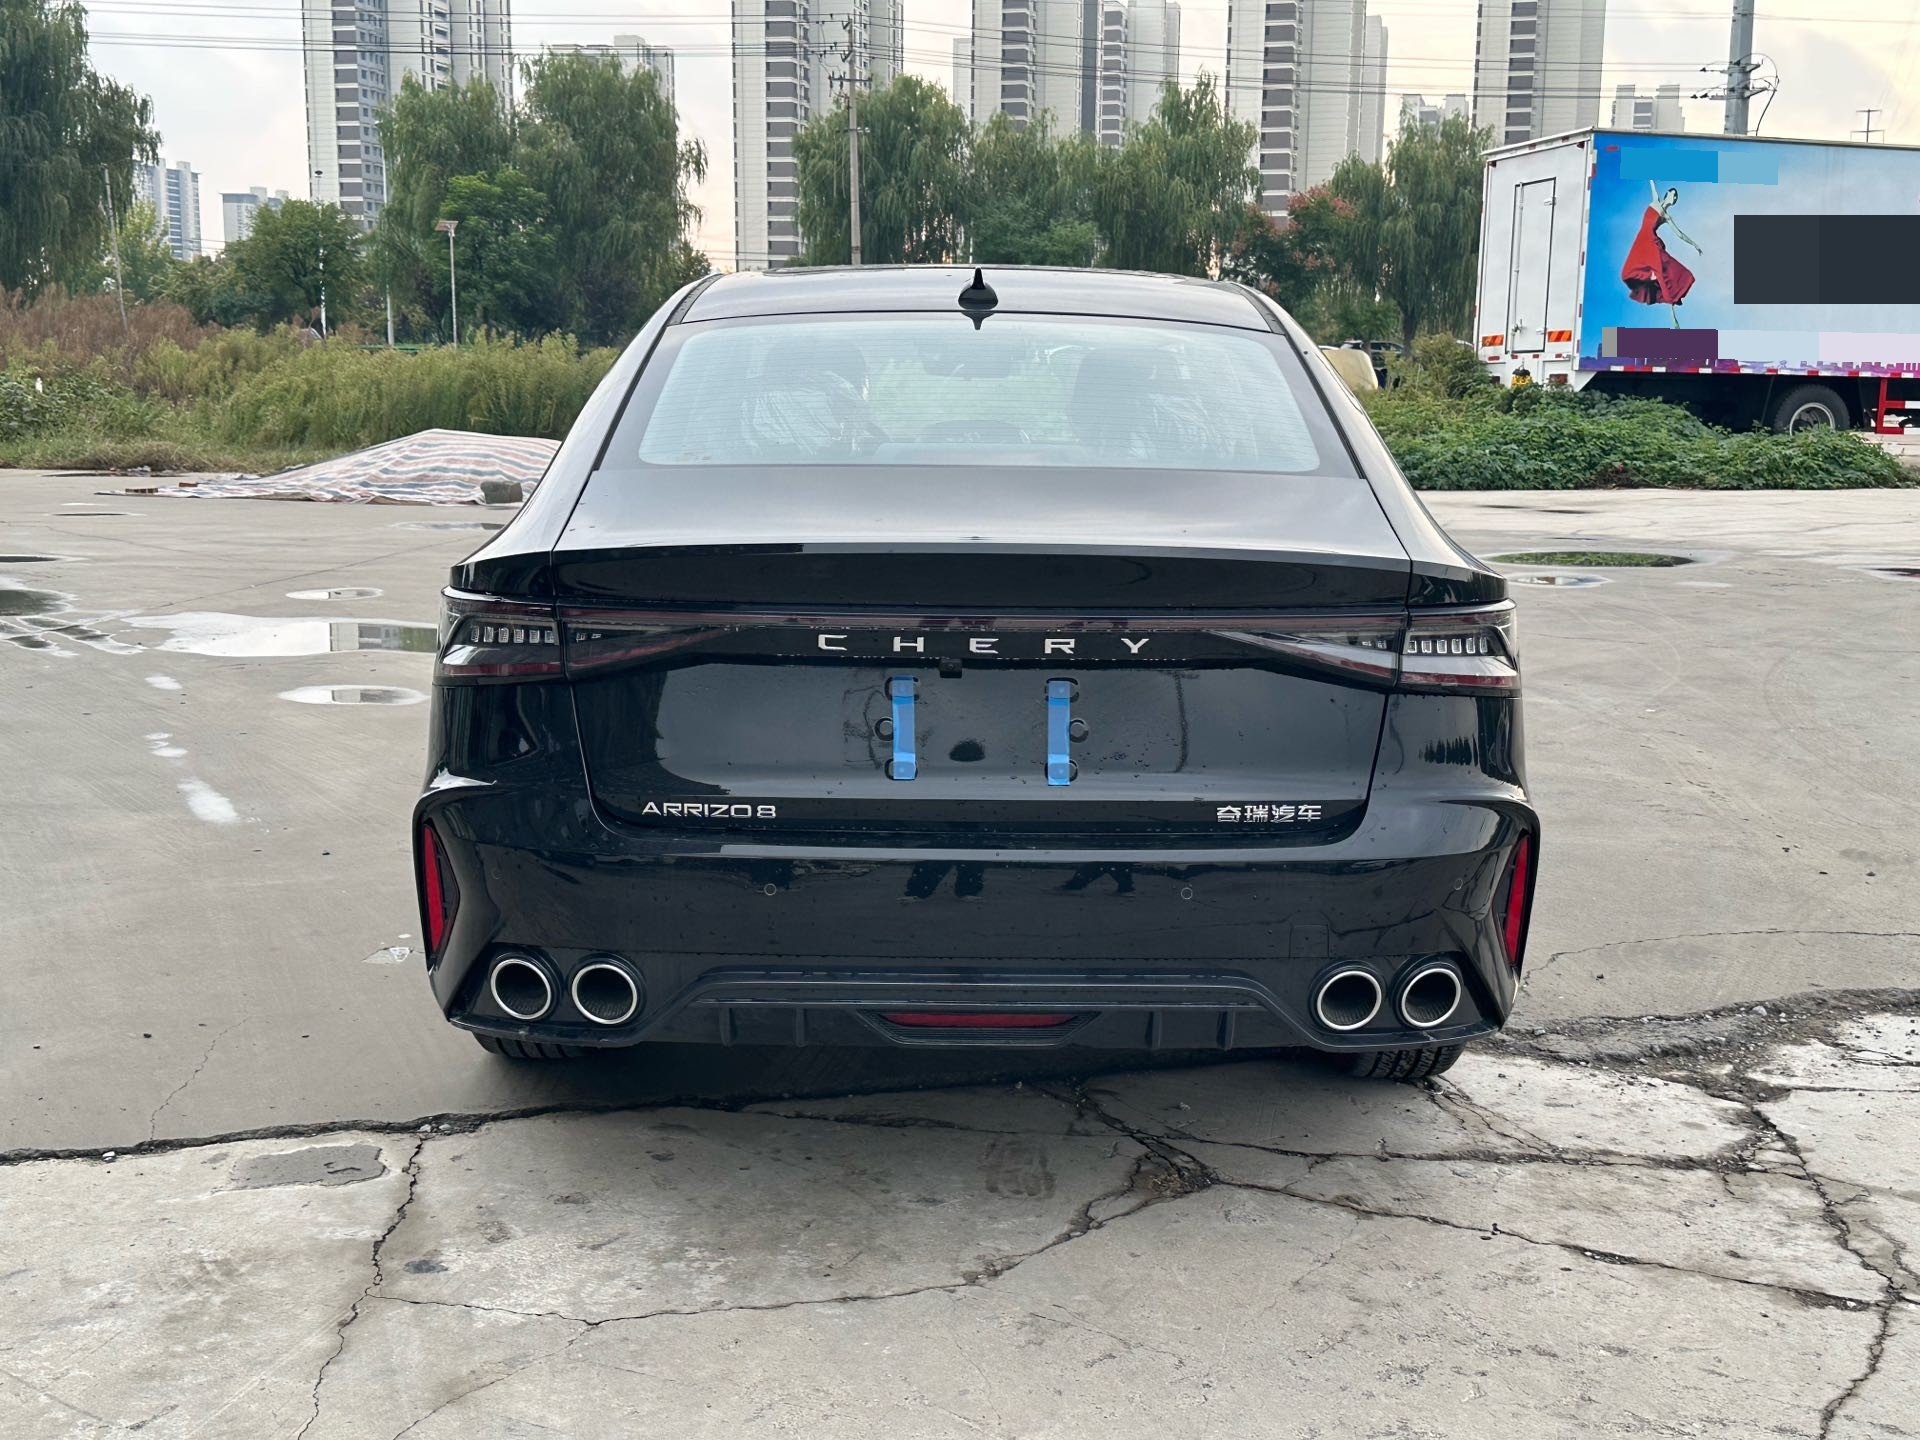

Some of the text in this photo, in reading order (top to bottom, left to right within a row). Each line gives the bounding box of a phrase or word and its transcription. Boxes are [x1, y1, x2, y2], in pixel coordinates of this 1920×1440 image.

[817, 634, 1150, 655] CHERY
[1216, 804, 1322, 823] 奇瑞汽车
